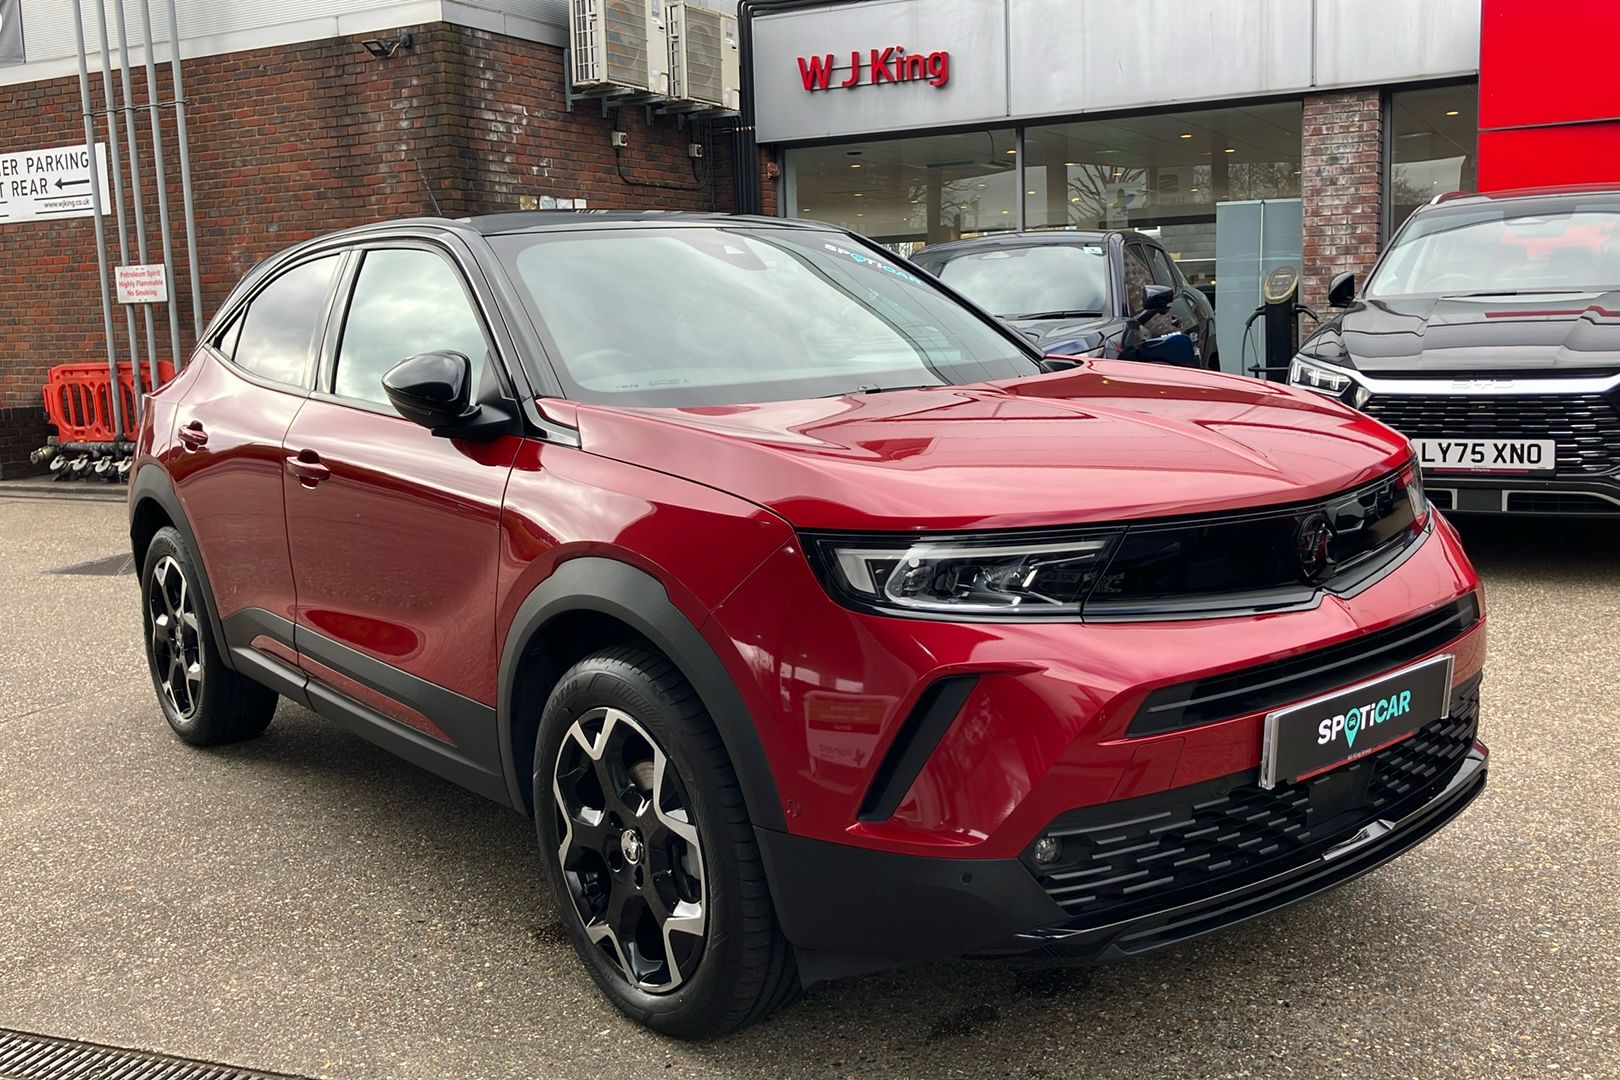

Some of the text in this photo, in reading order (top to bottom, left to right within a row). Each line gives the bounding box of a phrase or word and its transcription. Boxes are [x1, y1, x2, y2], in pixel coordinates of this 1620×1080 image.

[797, 46, 949, 91] W J King
[26, 151, 89, 174] PARKING
[11, 178, 48, 197] REAR
[44, 198, 90, 208] www.wjking.co.uk
[1422, 443, 1542, 464] LY75 XNO
